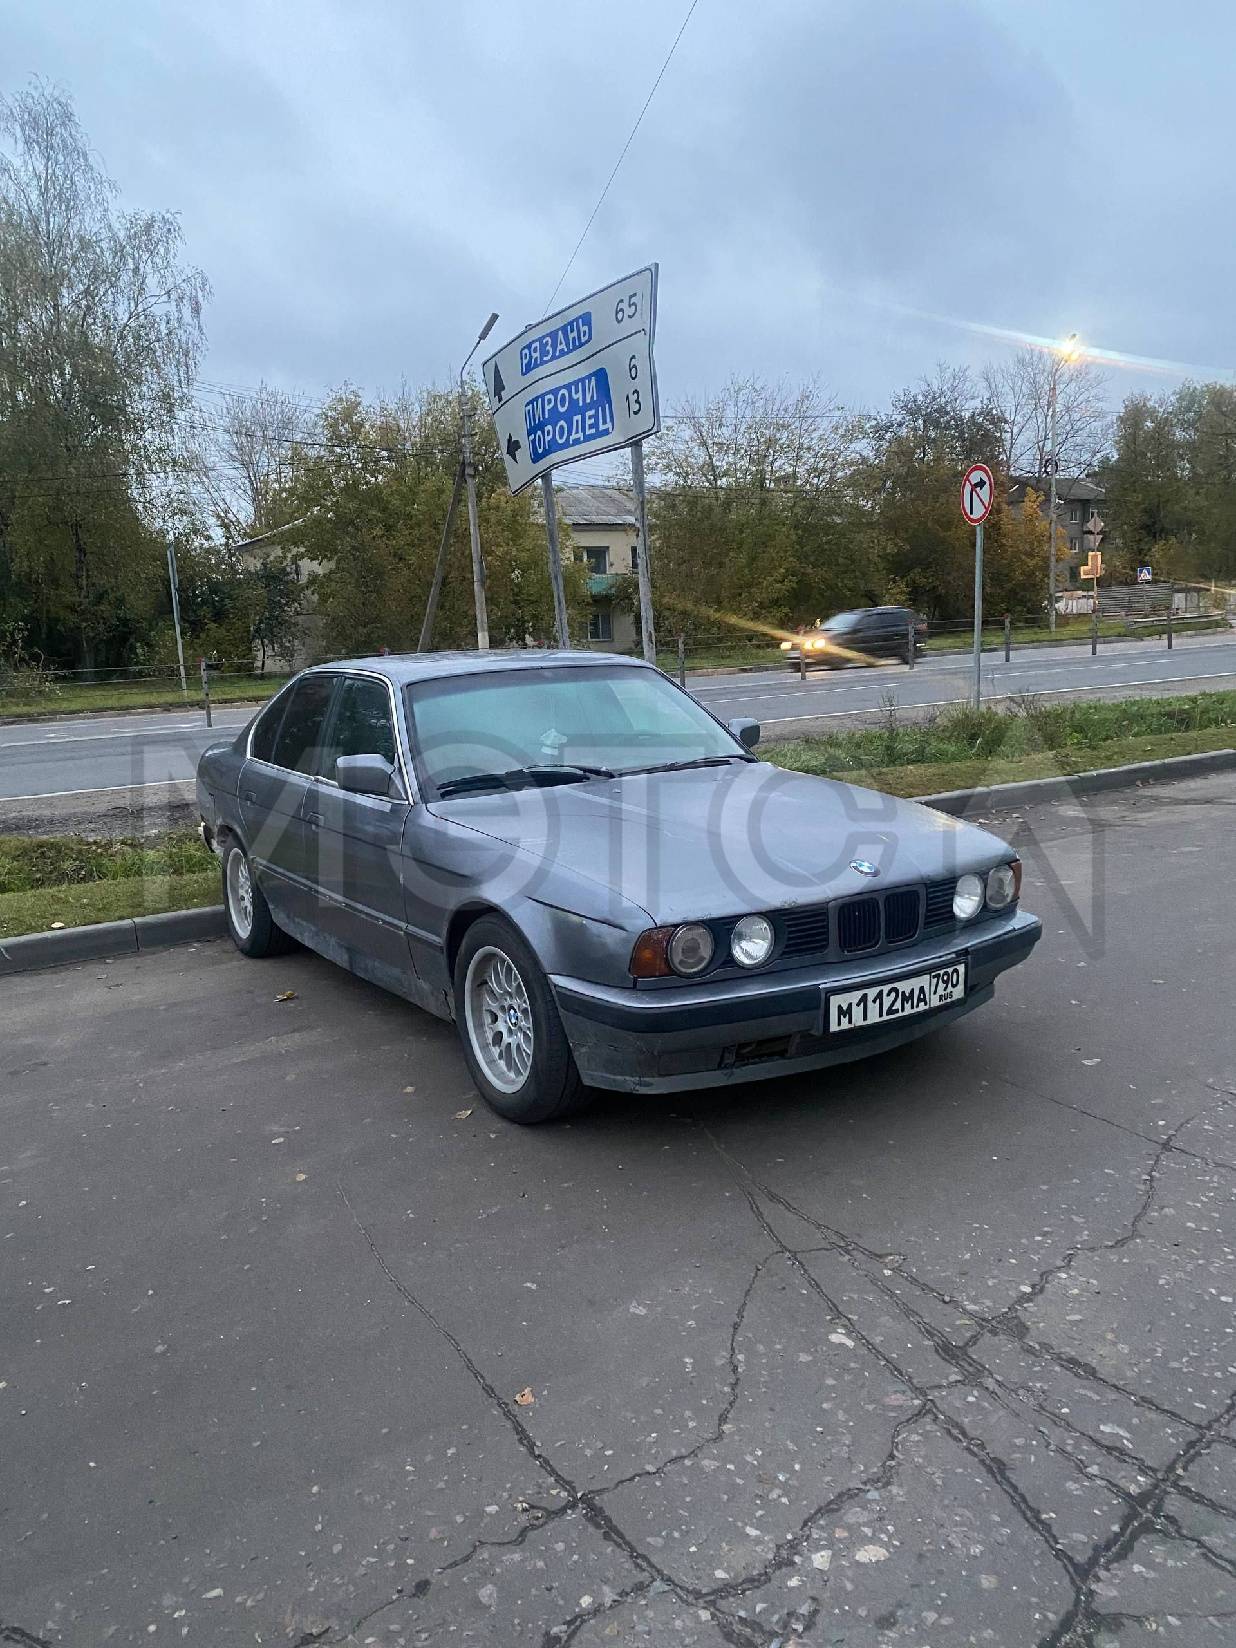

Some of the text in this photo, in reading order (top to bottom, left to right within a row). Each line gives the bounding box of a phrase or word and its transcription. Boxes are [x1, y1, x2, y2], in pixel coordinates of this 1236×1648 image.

[522, 292, 638, 373] РЯЗАНЬ 65
[525, 354, 638, 430] ПИРОЧИ 6
[528, 388, 642, 459] ГОРОДЕЦ 13
[932, 968, 960, 995] 790
[938, 991, 953, 1003] RUS
